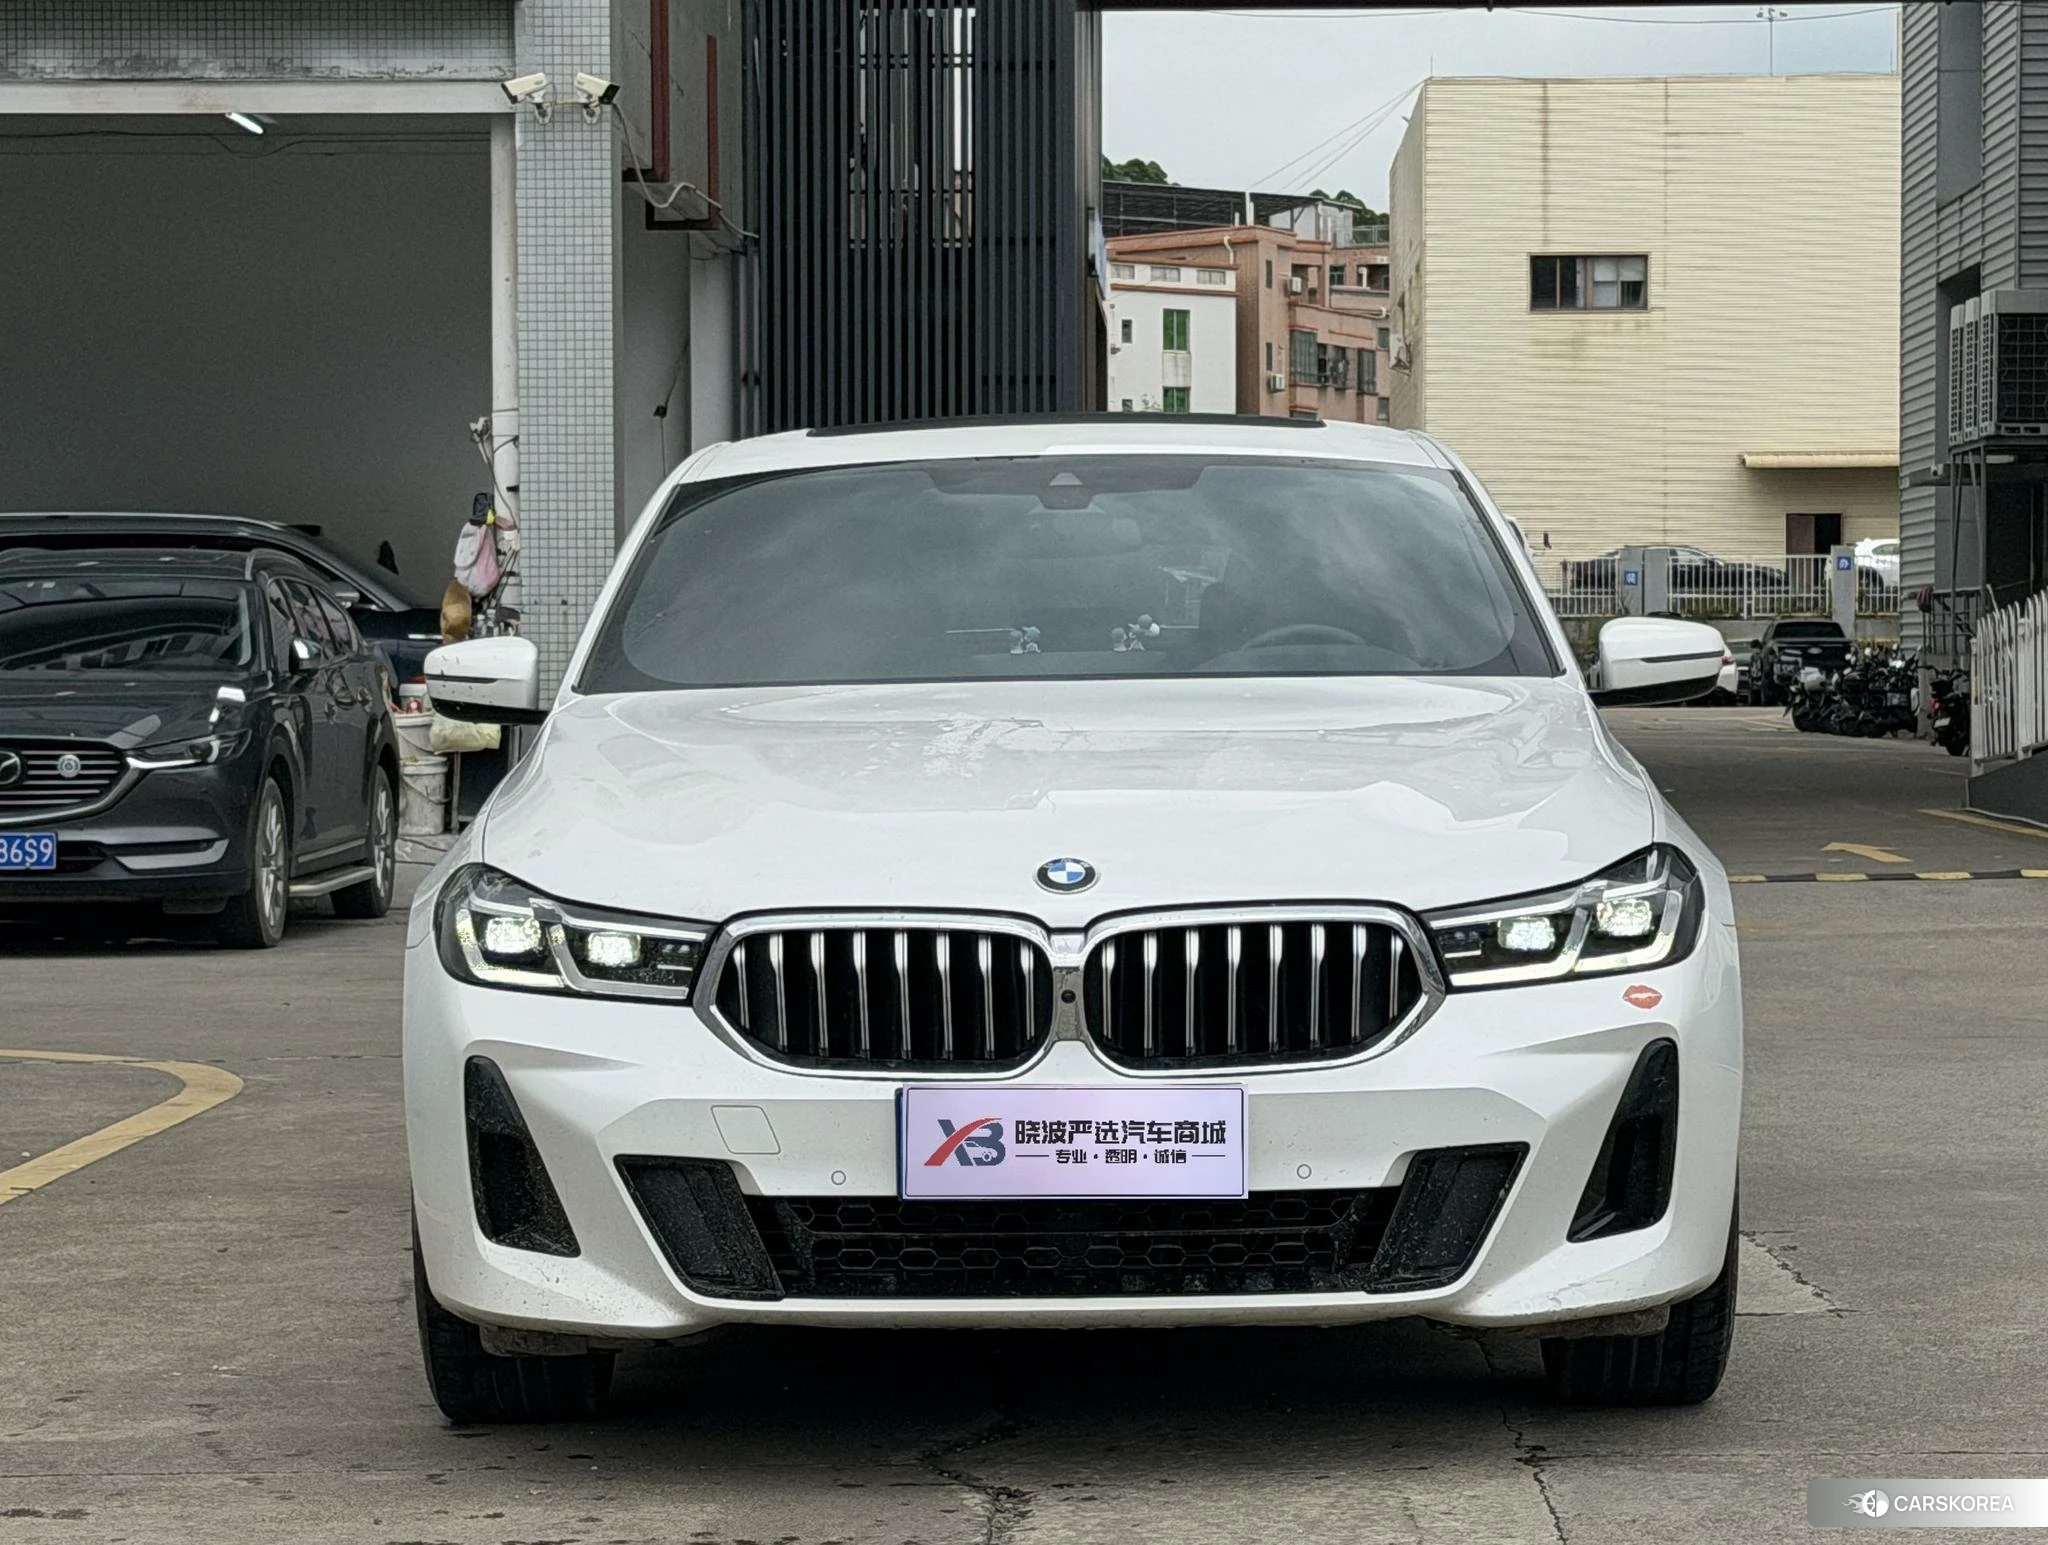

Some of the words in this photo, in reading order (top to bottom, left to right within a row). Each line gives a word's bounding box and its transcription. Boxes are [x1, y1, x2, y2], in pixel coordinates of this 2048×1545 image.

[1015, 1120, 1226, 1144] 晓波严选汽车商城
